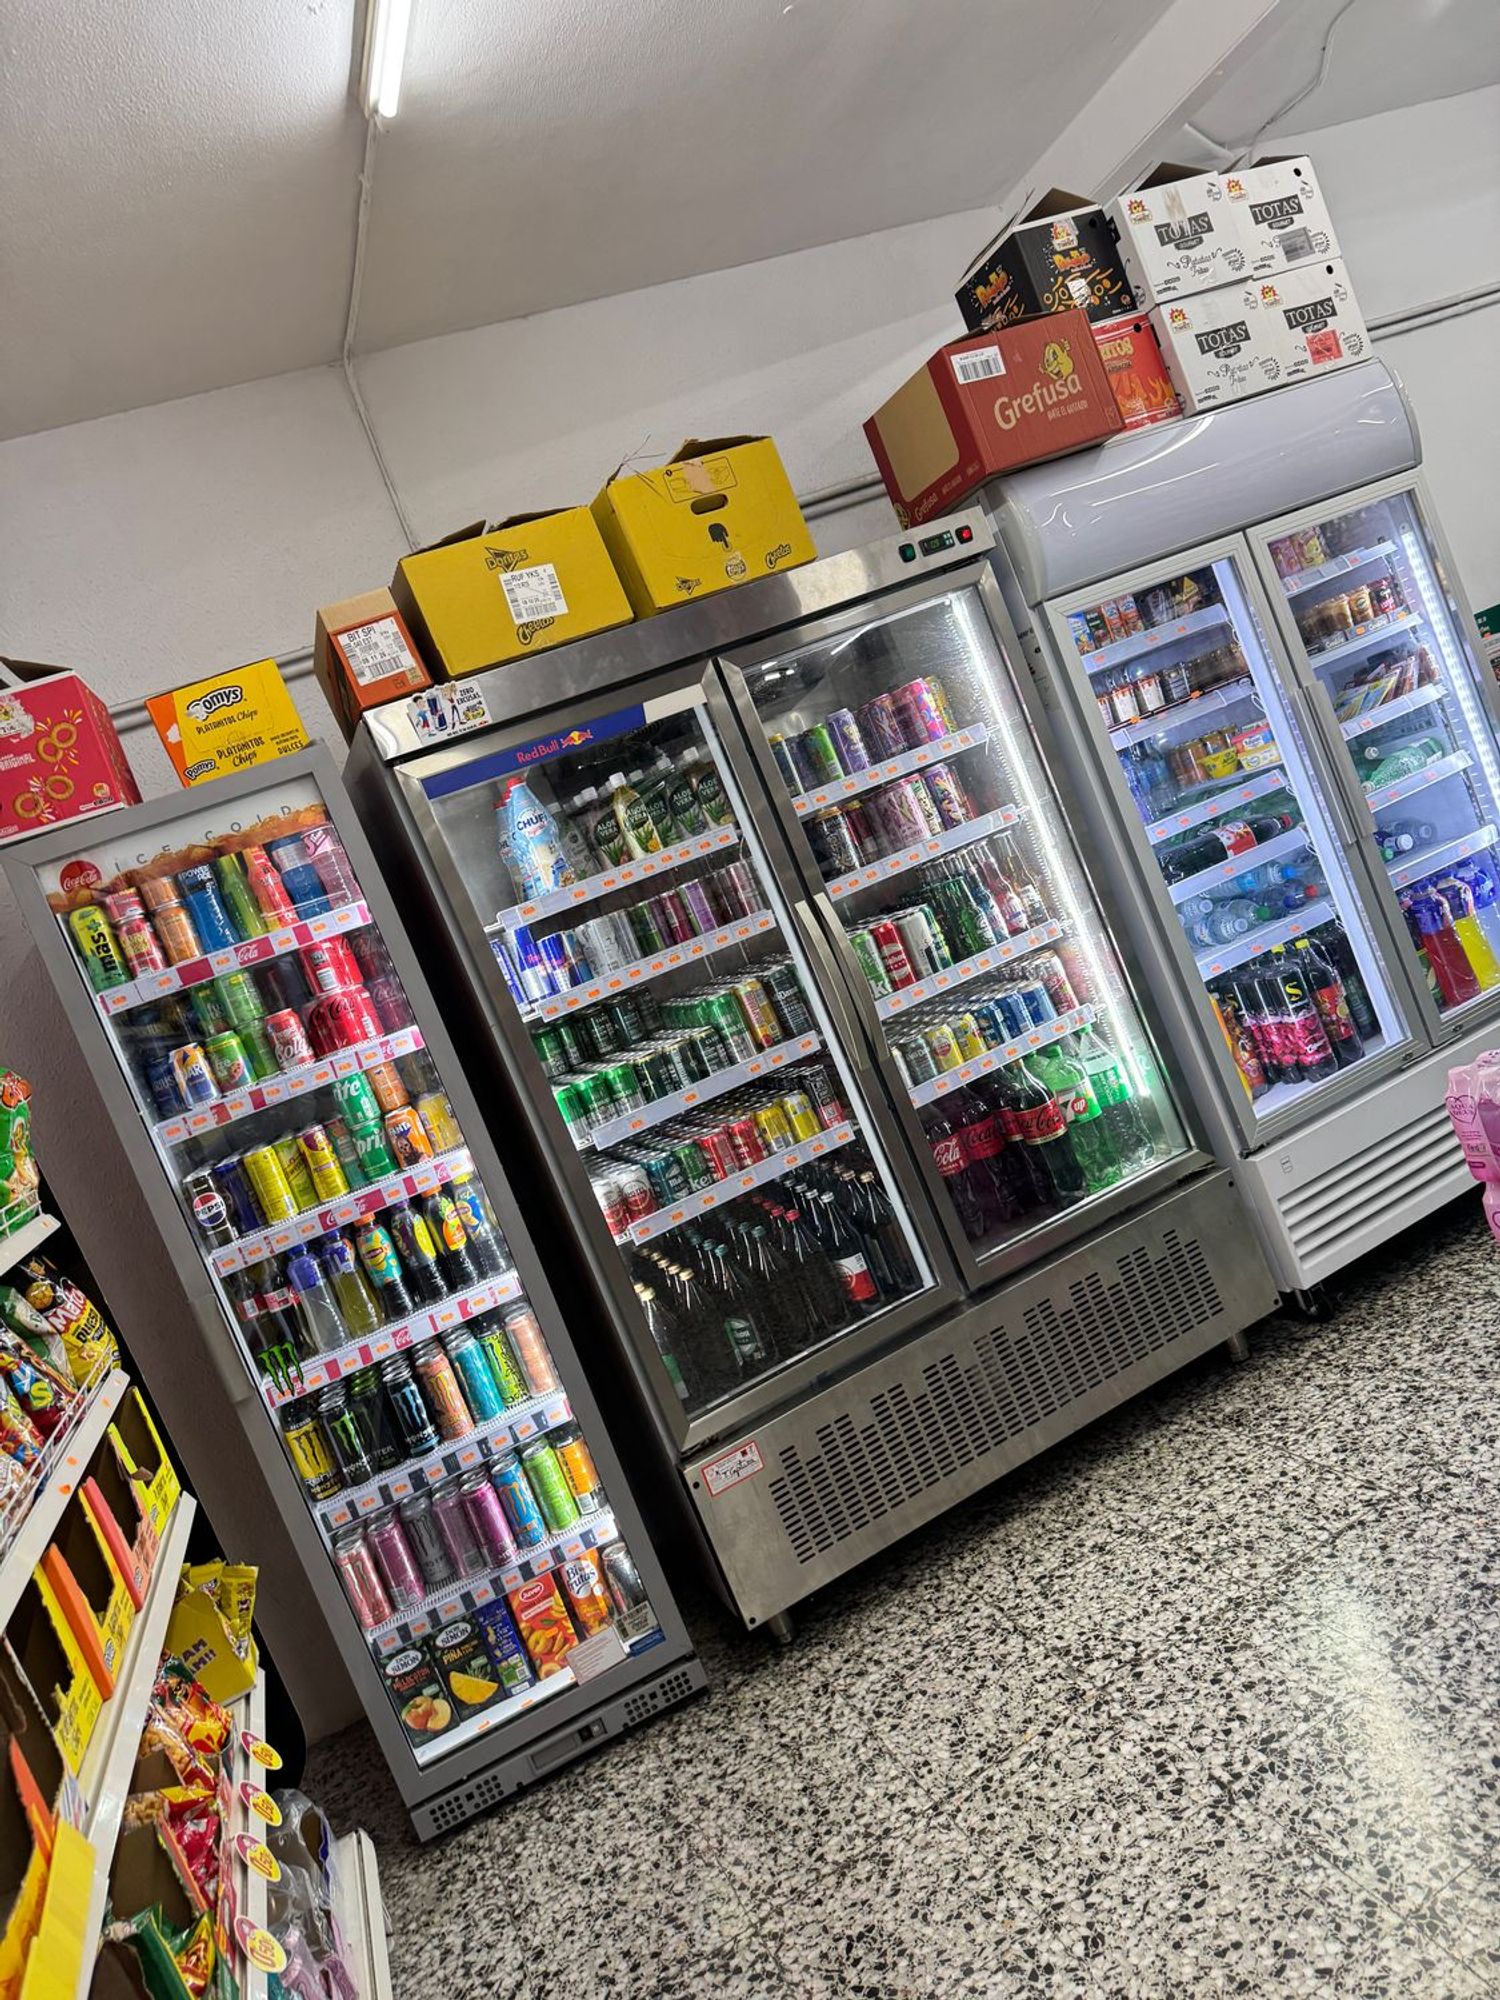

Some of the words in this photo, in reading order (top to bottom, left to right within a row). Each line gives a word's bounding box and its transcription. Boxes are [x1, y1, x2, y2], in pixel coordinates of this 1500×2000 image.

[1253, 198, 1300, 223] TOTAS
[1287, 302, 1335, 326] TOTAS
[1199, 324, 1247, 351] TOTAS
[993, 373, 1083, 430] Grefusa
[914, 492, 939, 521] Grefusa
[486, 550, 529, 570] Doritos
[347, 631, 361, 643] BIT
[362, 626, 377, 638] SPI
[517, 616, 555, 645] Cheetos
[459, 686, 475, 696] ZERO
[196, 715, 237, 735] PLATANITOS
[237, 708, 259, 723] Chips
[216, 736, 265, 760] PLATANITOS
[277, 740, 305, 755] DULCES
[517, 746, 538, 764] Red
[538, 740, 560, 759] Bull
[185, 758, 216, 780] Pomys
[232, 750, 258, 767] Chips
[672, 788, 693, 801] ALOE
[596, 818, 617, 832] ALOE
[63, 870, 98, 891] Coca-Cola
[934, 1137, 961, 1166] Cola
[196, 1200, 224, 1217] PEPSI
[522, 1584, 543, 1600] Juver
[441, 1627, 471, 1648] SIMON
[390, 1657, 422, 1676] SIMON
